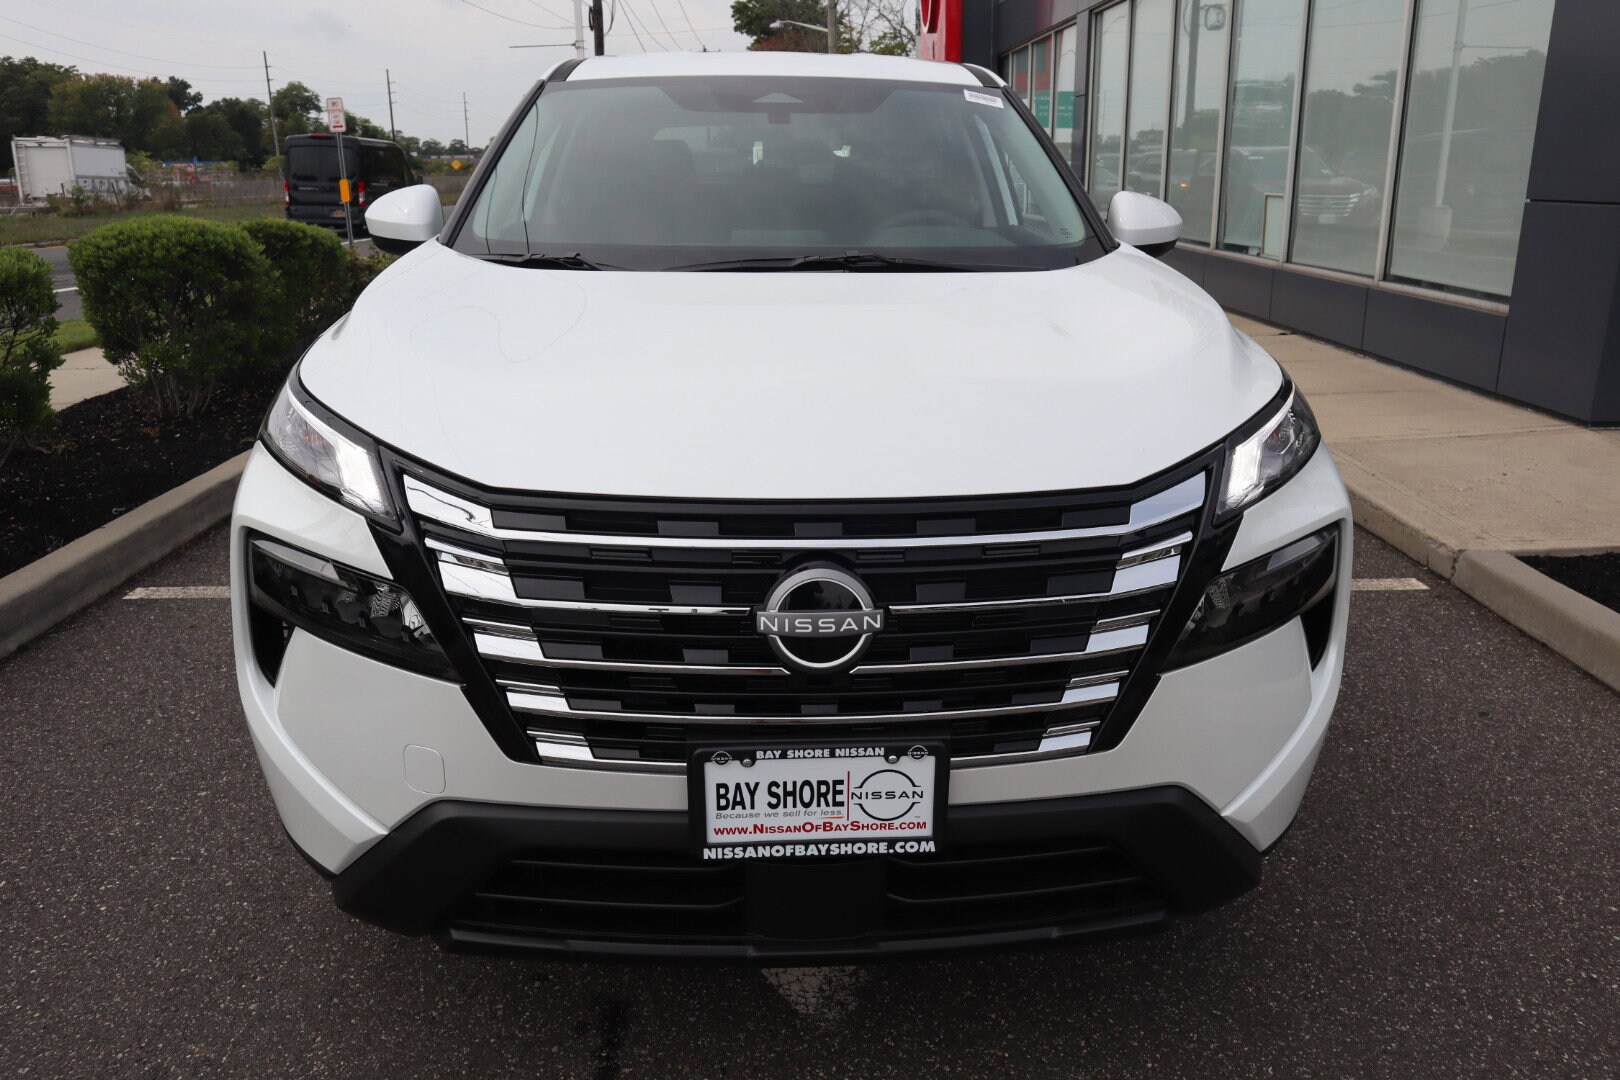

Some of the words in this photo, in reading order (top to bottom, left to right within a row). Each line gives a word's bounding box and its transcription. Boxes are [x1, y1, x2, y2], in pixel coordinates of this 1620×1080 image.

[760, 614, 881, 633] NISSAN
[756, 750, 781, 759] BAY
[787, 749, 830, 758] SHORE
[835, 747, 885, 757] NISSAN
[716, 782, 760, 811] BAY
[767, 779, 845, 809] SHORE
[851, 791, 923, 800] NISSAN
[715, 811, 760, 820] Because
[803, 809, 818, 817] for
[820, 808, 844, 816] less.
[703, 841, 936, 859] NISSANOFBAYSHORE.COM
